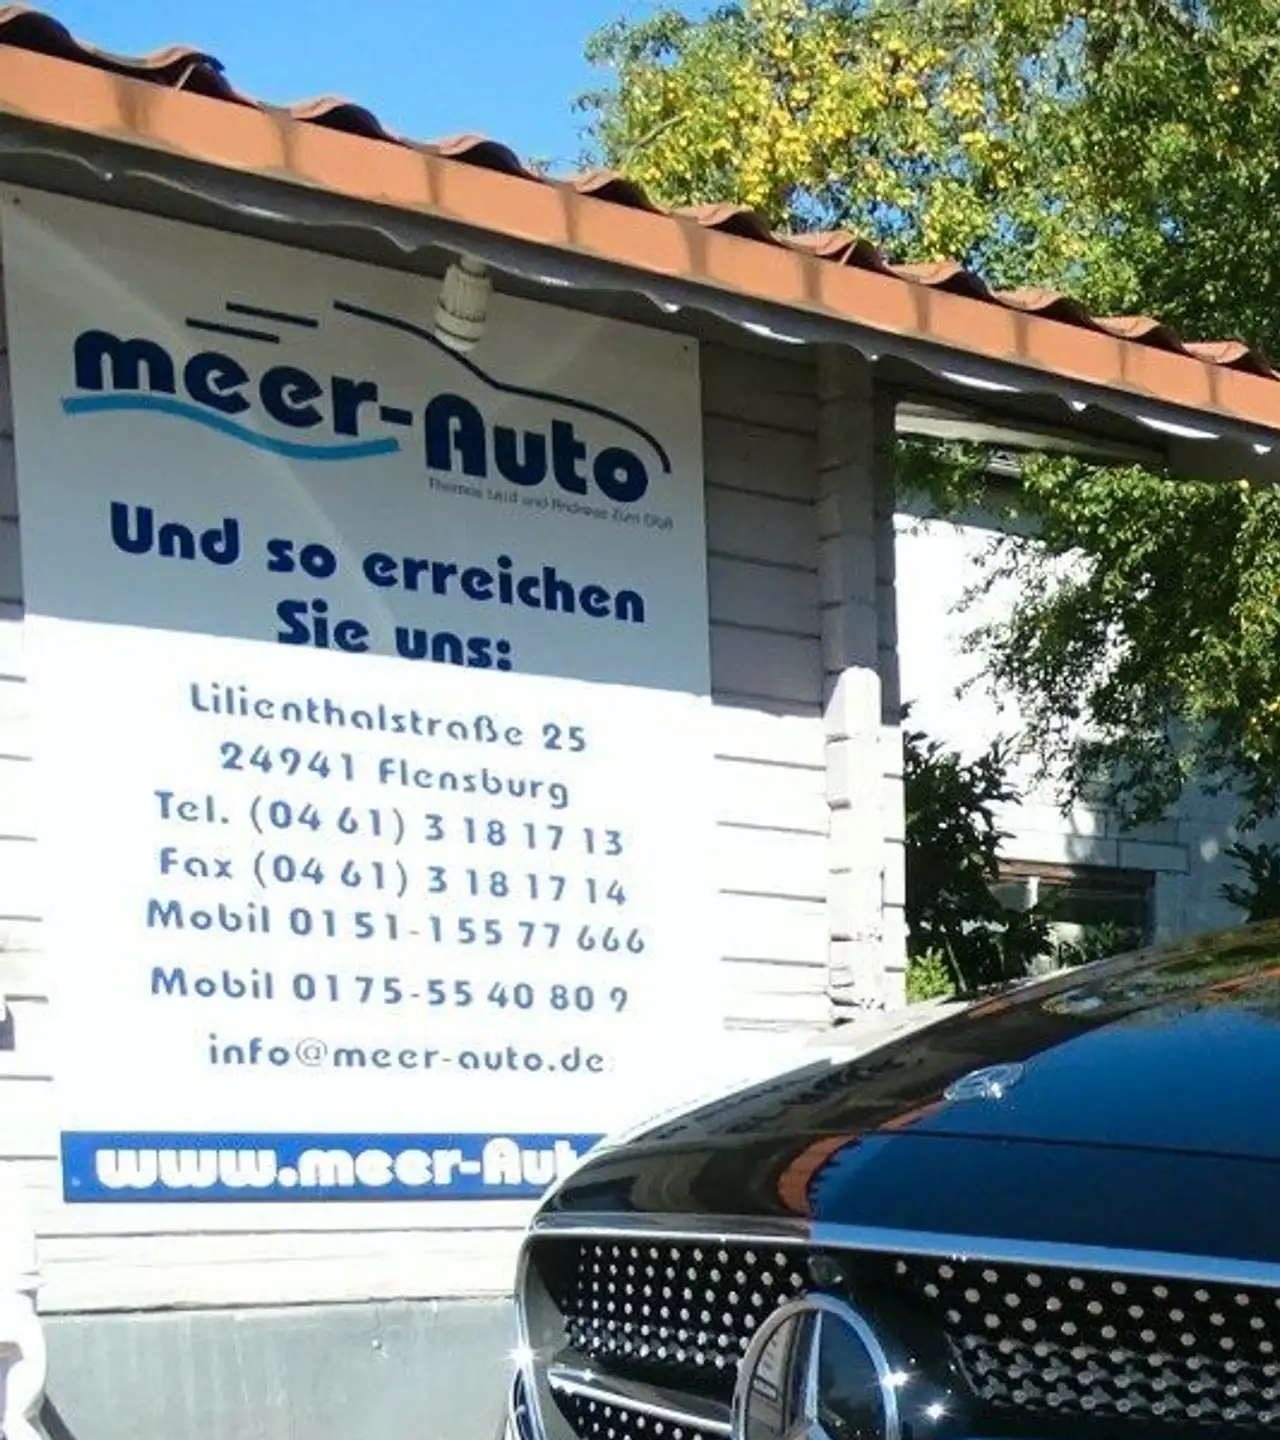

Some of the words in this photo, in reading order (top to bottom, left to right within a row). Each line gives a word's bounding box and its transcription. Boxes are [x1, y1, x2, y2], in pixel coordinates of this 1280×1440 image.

[72, 328, 650, 503] meer-Auto
[110, 501, 240, 566] Und
[266, 536, 337, 579] so
[362, 550, 646, 623] erreichen
[275, 598, 370, 654] Sie
[395, 624, 513, 673] uns:
[190, 681, 524, 746] Lilienthalstraße
[541, 722, 587, 752] 25
[219, 741, 354, 782] 24941
[378, 757, 569, 810] Flensburg
[153, 789, 230, 826] Tel.
[159, 846, 234, 881] Fax
[146, 897, 271, 934] Mobil
[151, 965, 274, 1001] Mobil
[208, 1031, 606, 1073] info@meer-auto.de
